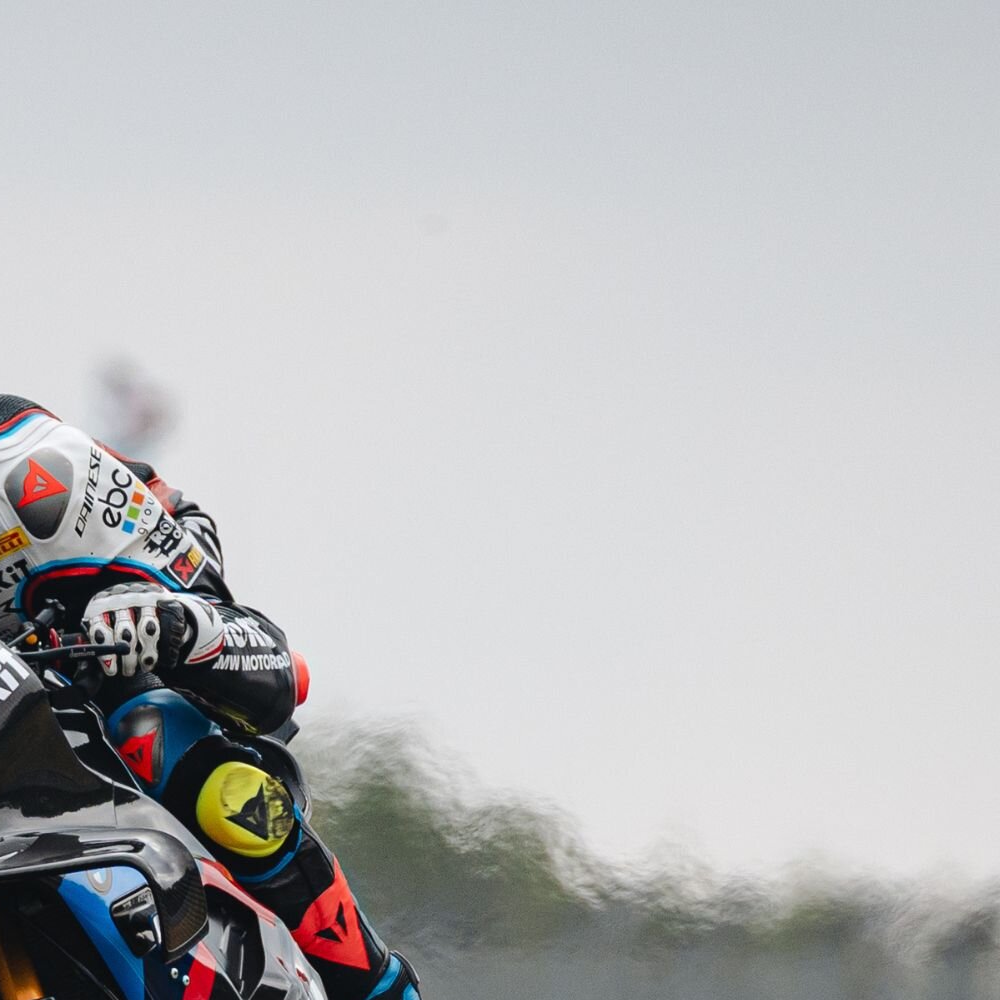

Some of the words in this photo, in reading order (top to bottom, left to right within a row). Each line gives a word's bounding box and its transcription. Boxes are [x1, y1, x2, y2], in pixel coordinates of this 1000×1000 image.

[73, 446, 102, 538] DAINESE
[98, 468, 133, 528] ebc
[137, 499, 156, 535] grou
[213, 655, 240, 671] MW
